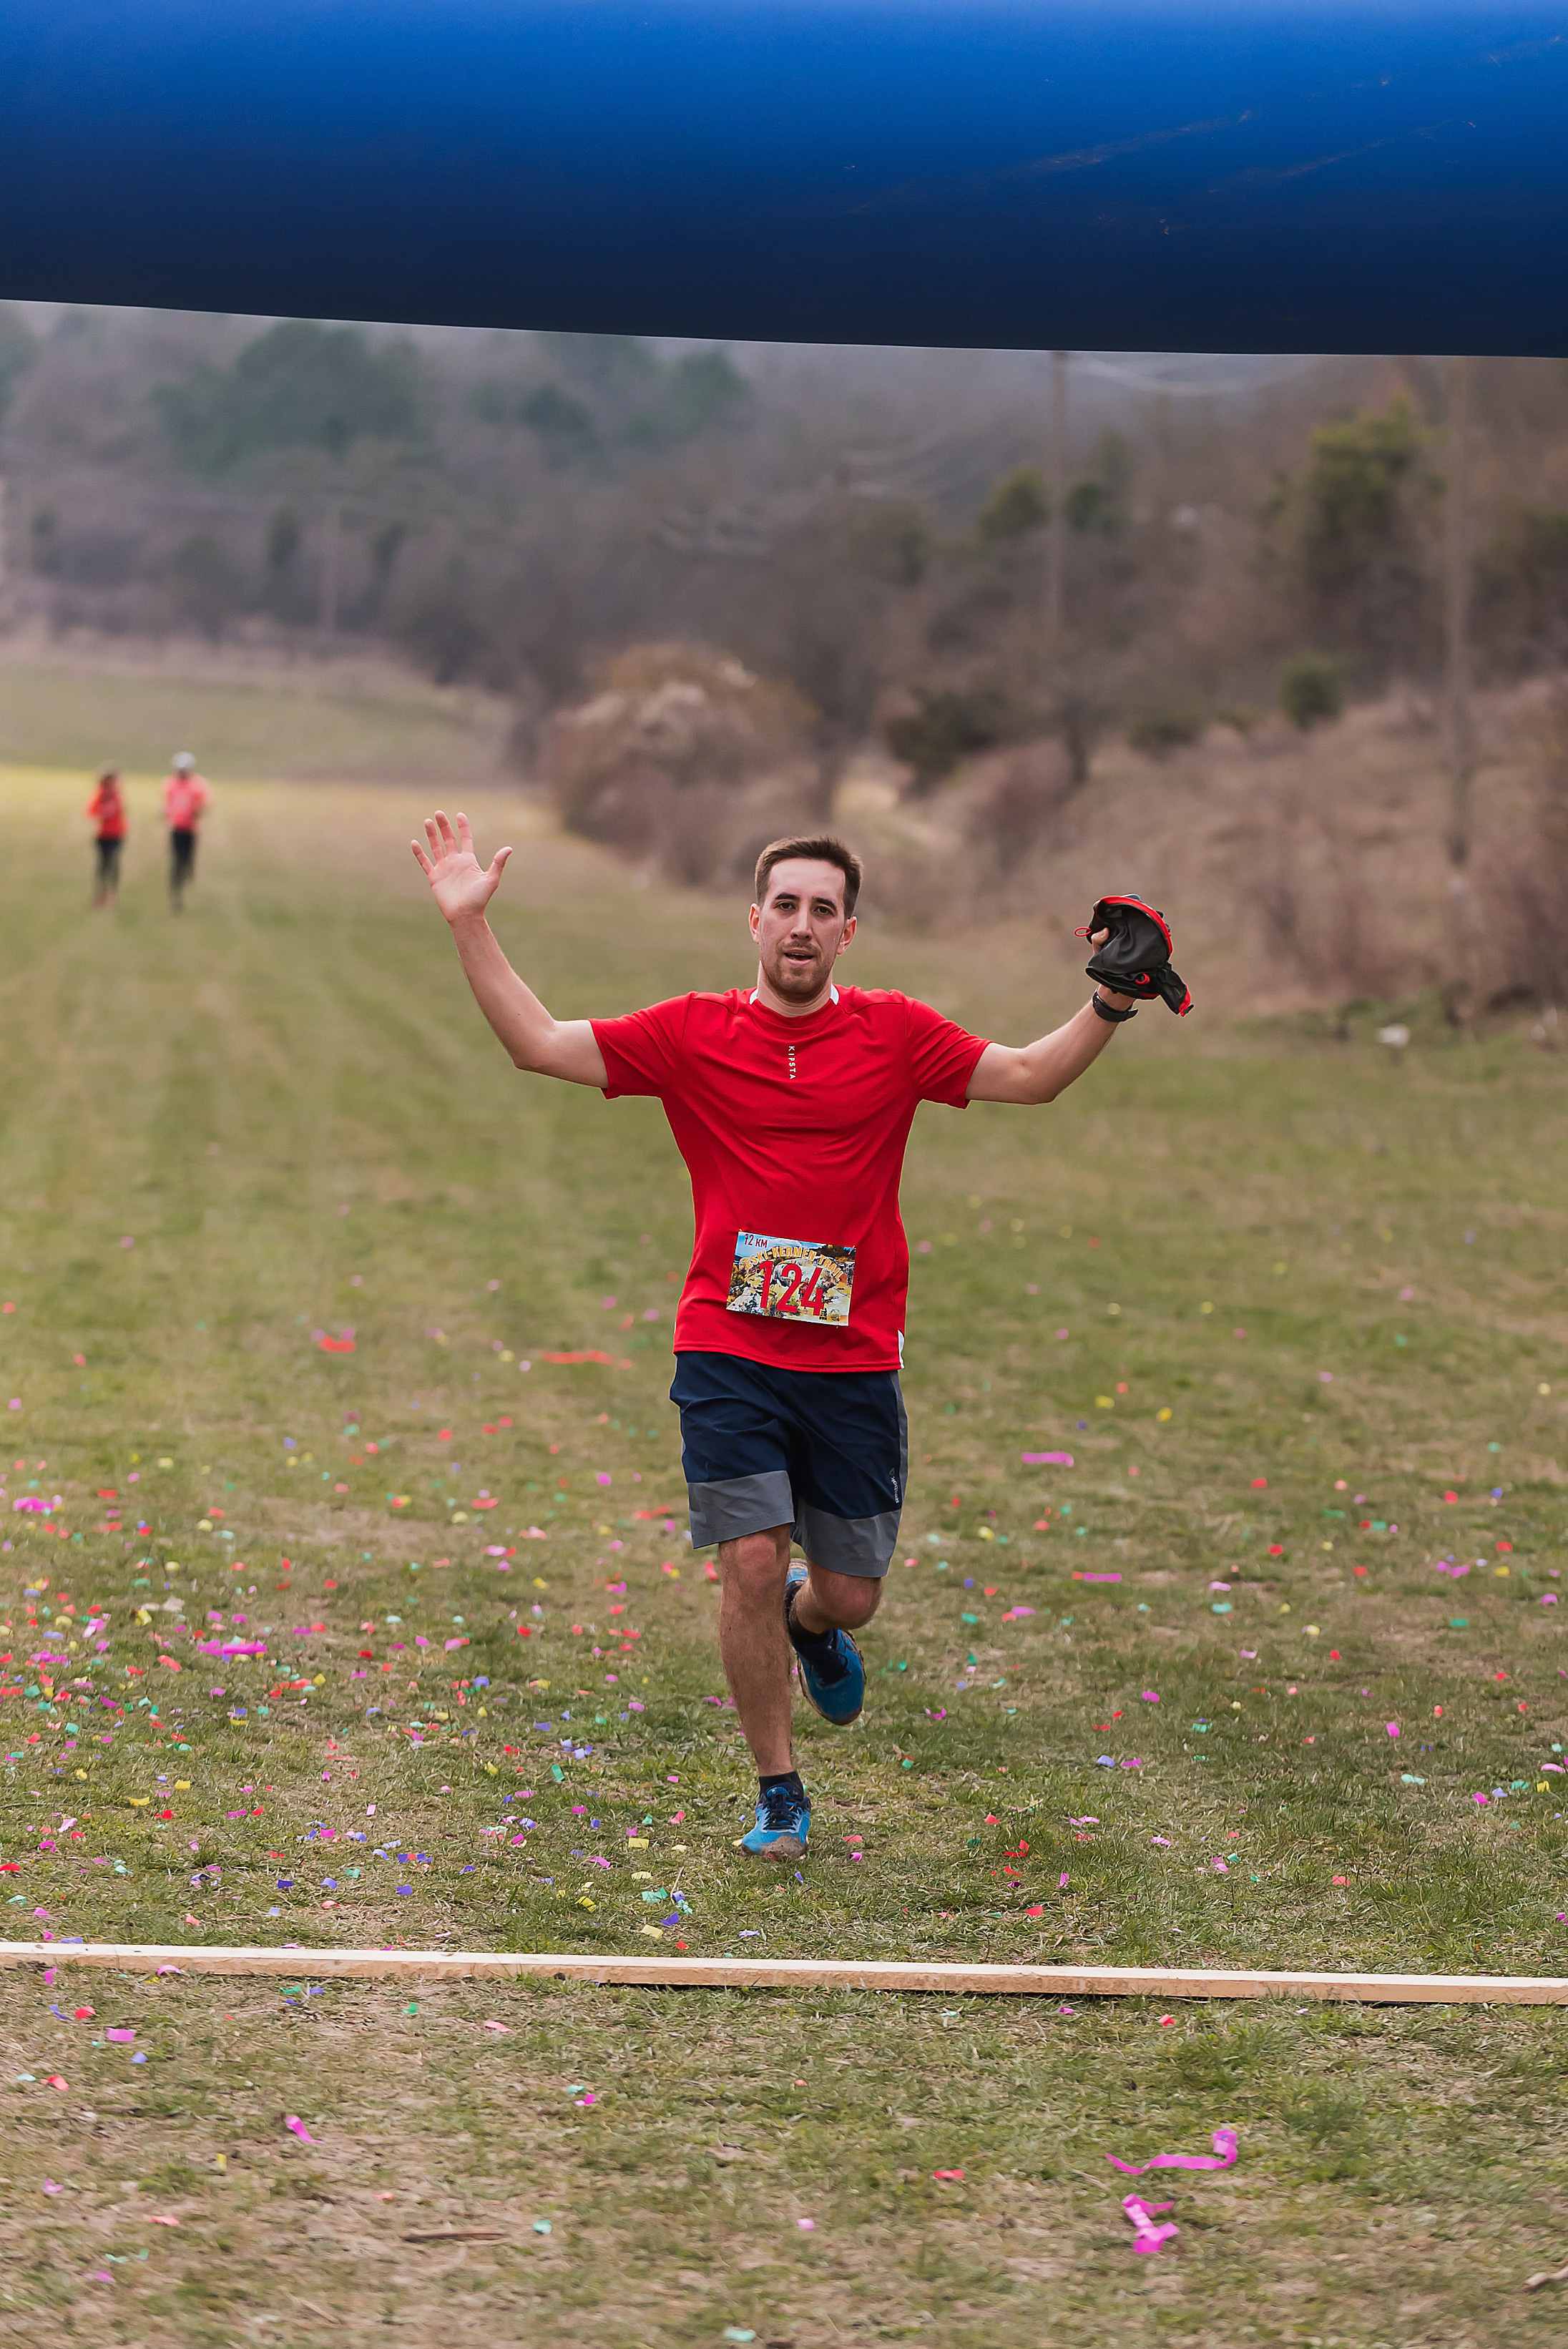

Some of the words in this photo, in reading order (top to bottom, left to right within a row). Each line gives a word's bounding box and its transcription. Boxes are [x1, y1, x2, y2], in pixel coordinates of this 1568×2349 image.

[745, 1234, 754, 1246] 12
[755, 1238, 768, 1248] KM
[745, 1246, 818, 1268] ESKI-KERMEN
[818, 1255, 844, 1282] TRAIL
[759, 1260, 824, 1316] 124
